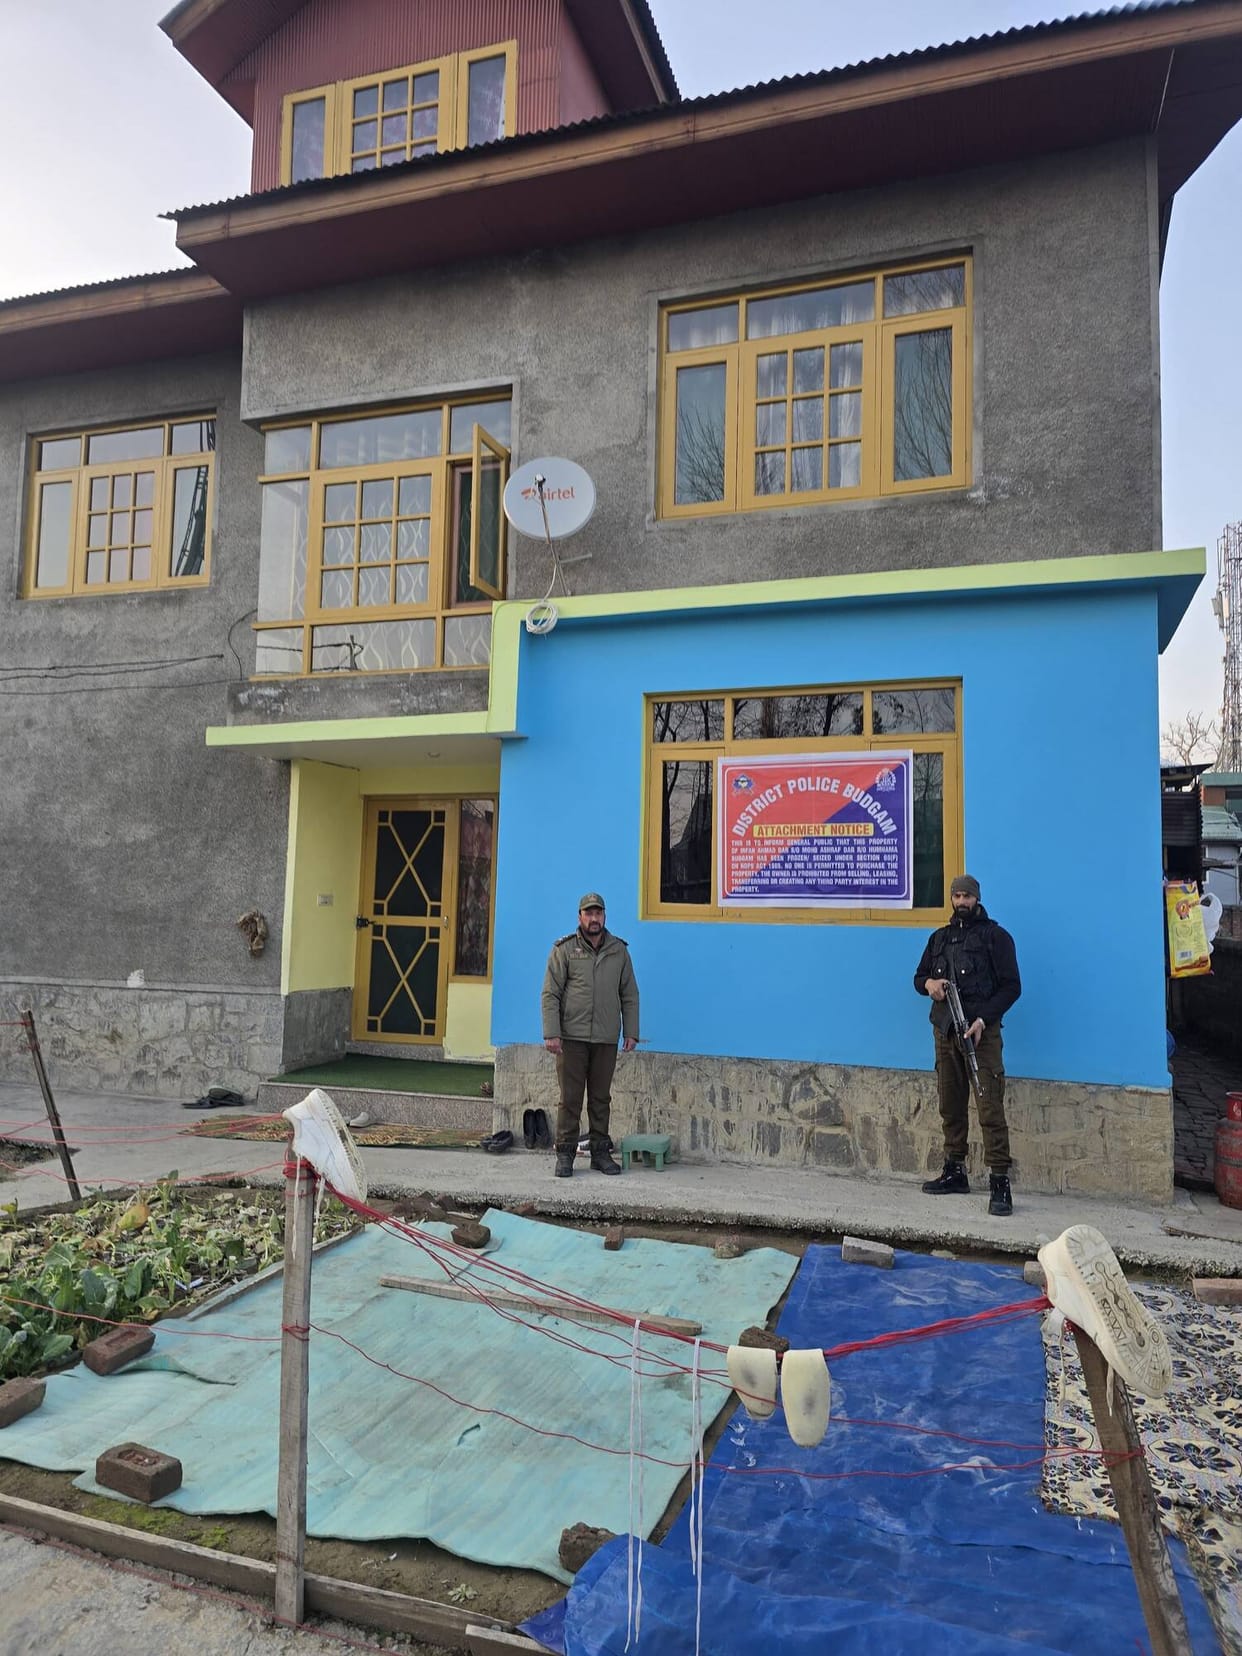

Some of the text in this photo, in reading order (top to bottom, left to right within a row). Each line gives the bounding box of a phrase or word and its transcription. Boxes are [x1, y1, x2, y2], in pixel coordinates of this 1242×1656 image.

[732, 784, 784, 838] DISTRICT
[787, 776, 840, 794] POLICE
[842, 783, 898, 836] BUDGAM
[757, 824, 870, 836] ATTACHMENT NOTICE
